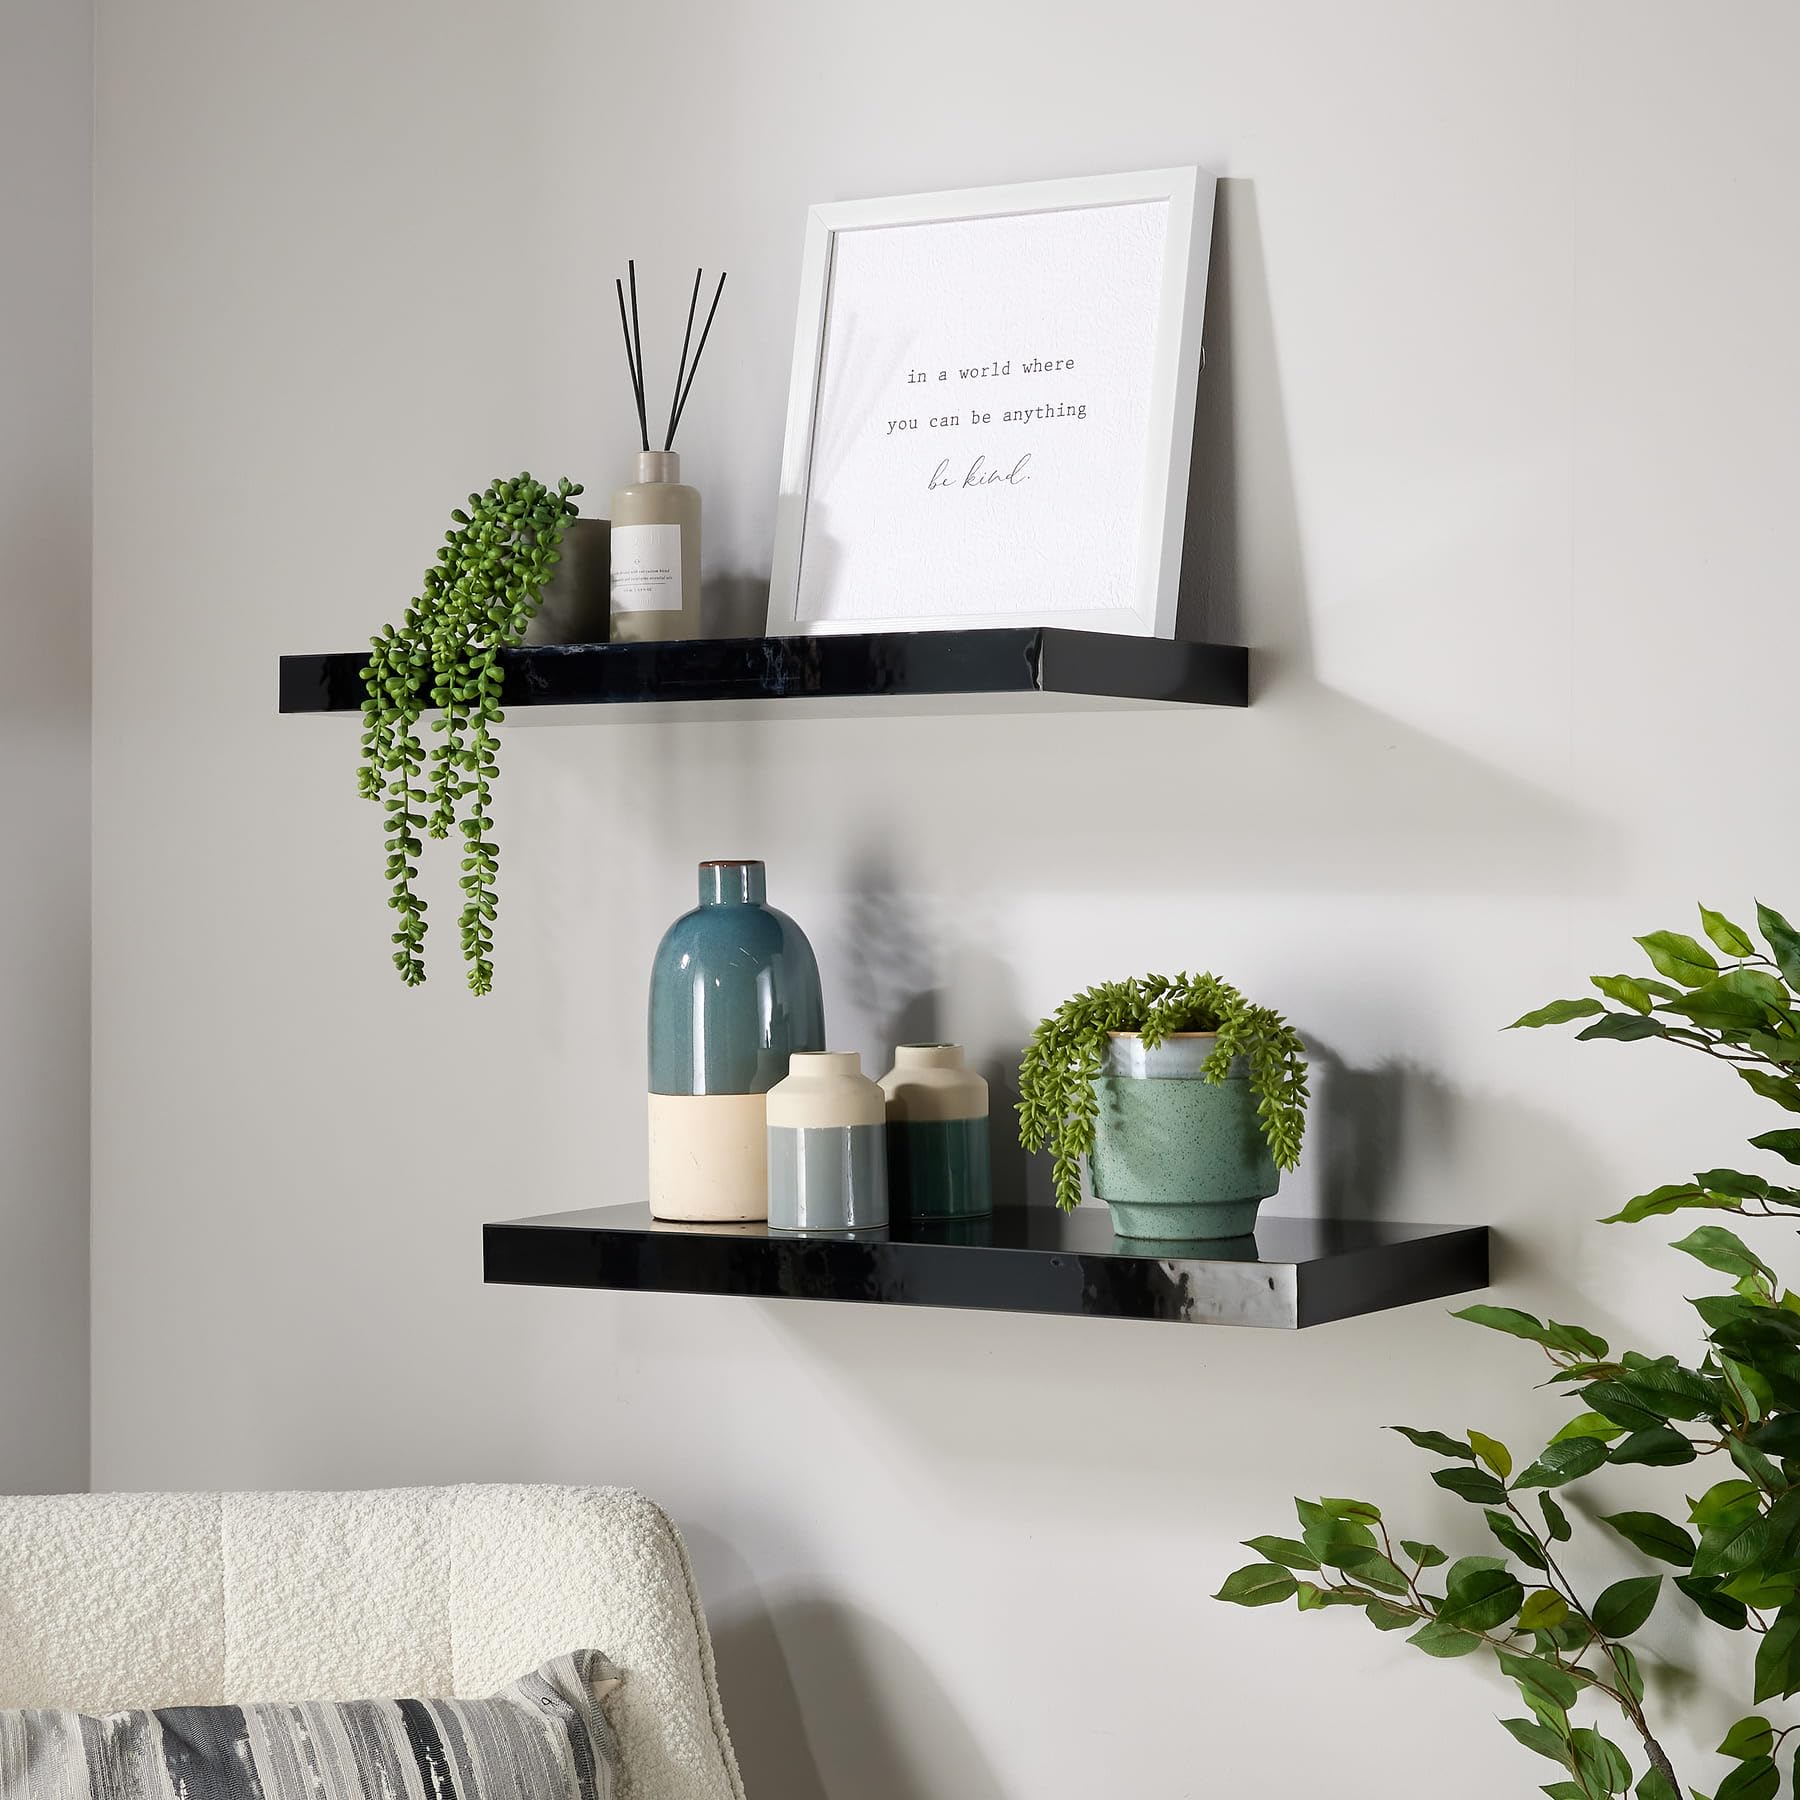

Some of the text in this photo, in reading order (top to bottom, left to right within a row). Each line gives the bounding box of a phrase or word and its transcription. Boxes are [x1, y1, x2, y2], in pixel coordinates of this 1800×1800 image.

[907, 358, 1074, 383] in a world where
[887, 403, 1086, 435] you can be anything
[928, 453, 1031, 490] be kind.
